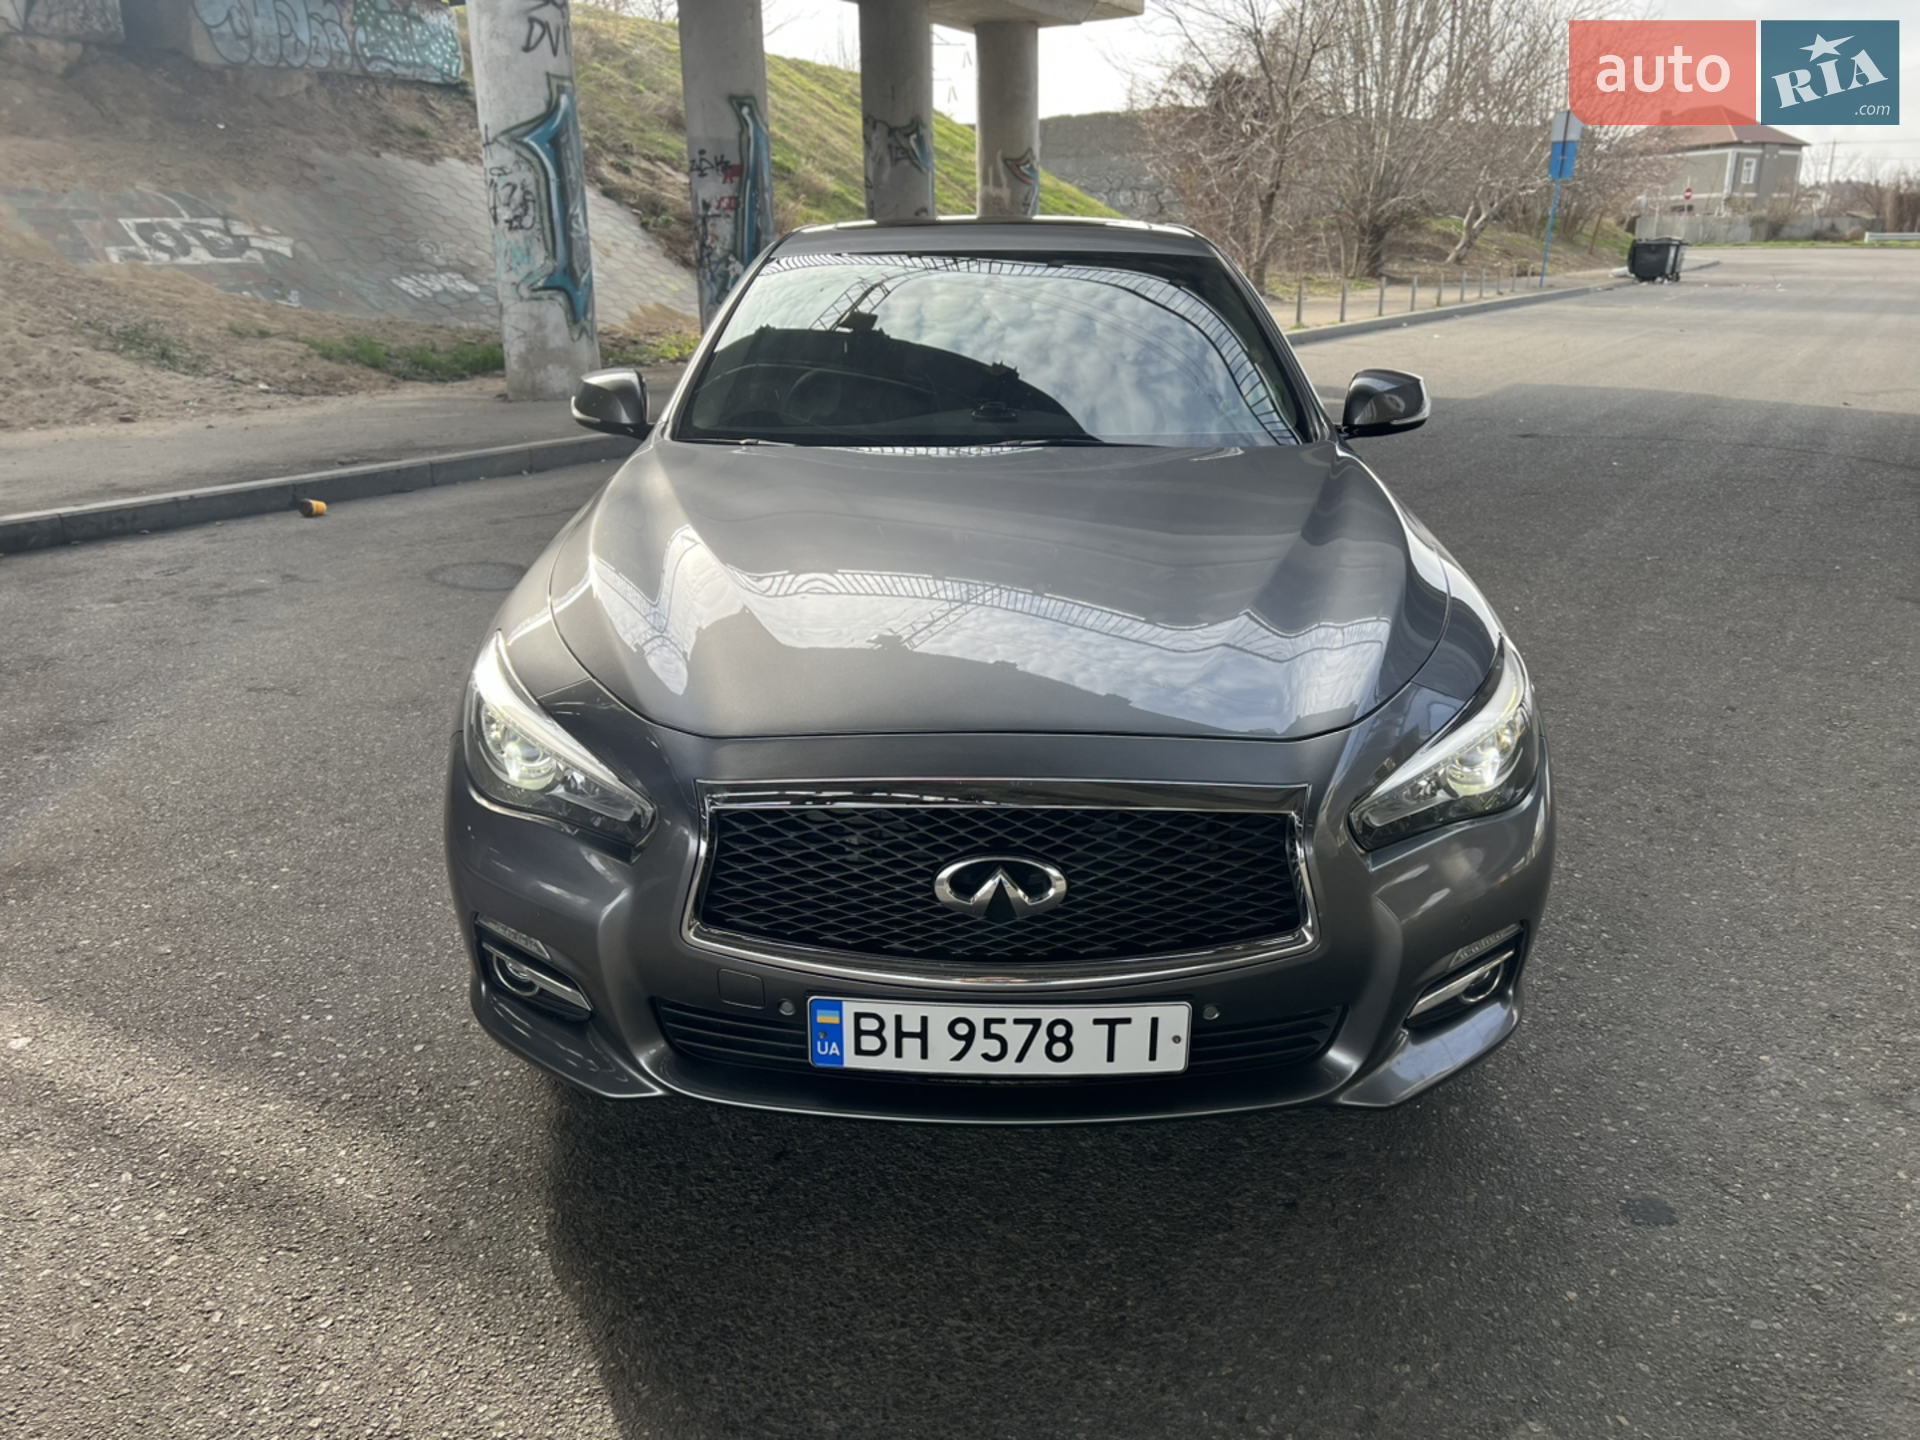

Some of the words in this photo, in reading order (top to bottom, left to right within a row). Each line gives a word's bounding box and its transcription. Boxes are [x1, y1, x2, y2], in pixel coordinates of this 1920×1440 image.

[816, 1040, 841, 1057] UA
[853, 1011, 929, 1060] BH
[946, 1016, 1075, 1064] 9578
